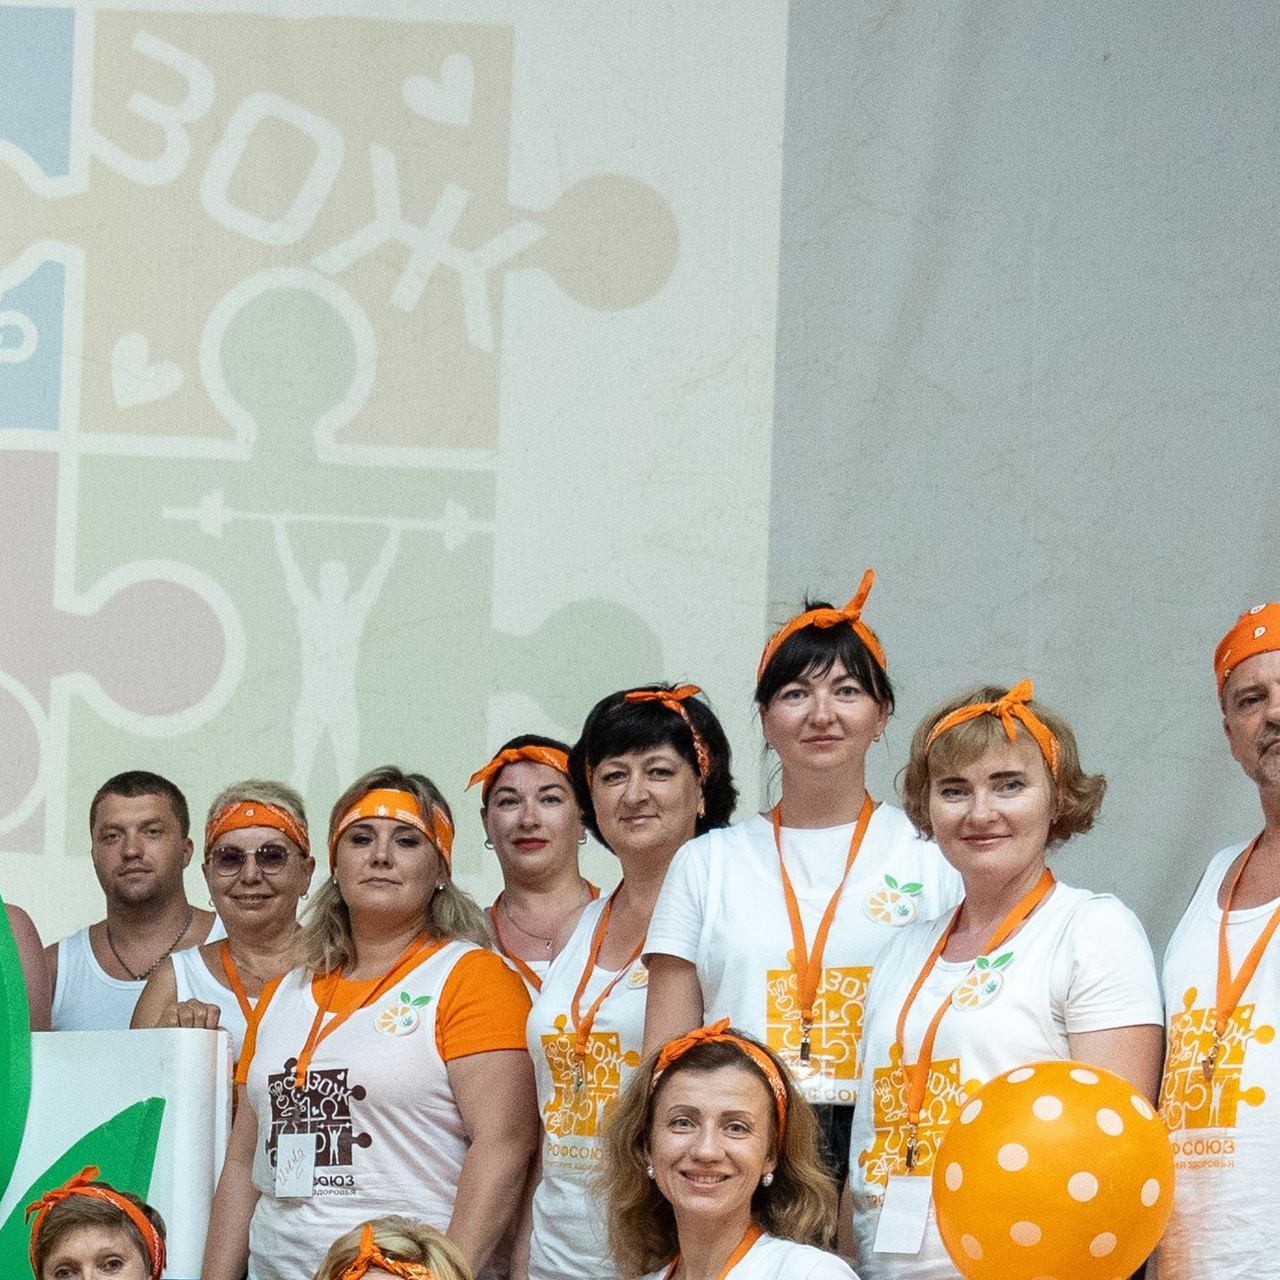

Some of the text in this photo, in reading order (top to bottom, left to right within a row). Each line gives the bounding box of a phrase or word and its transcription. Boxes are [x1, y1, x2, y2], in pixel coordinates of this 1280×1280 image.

[90, 30, 548, 353] ЗОЖ
[308, 1072, 353, 1106] ЗОЖ
[926, 1068, 965, 1107] ОЖ
